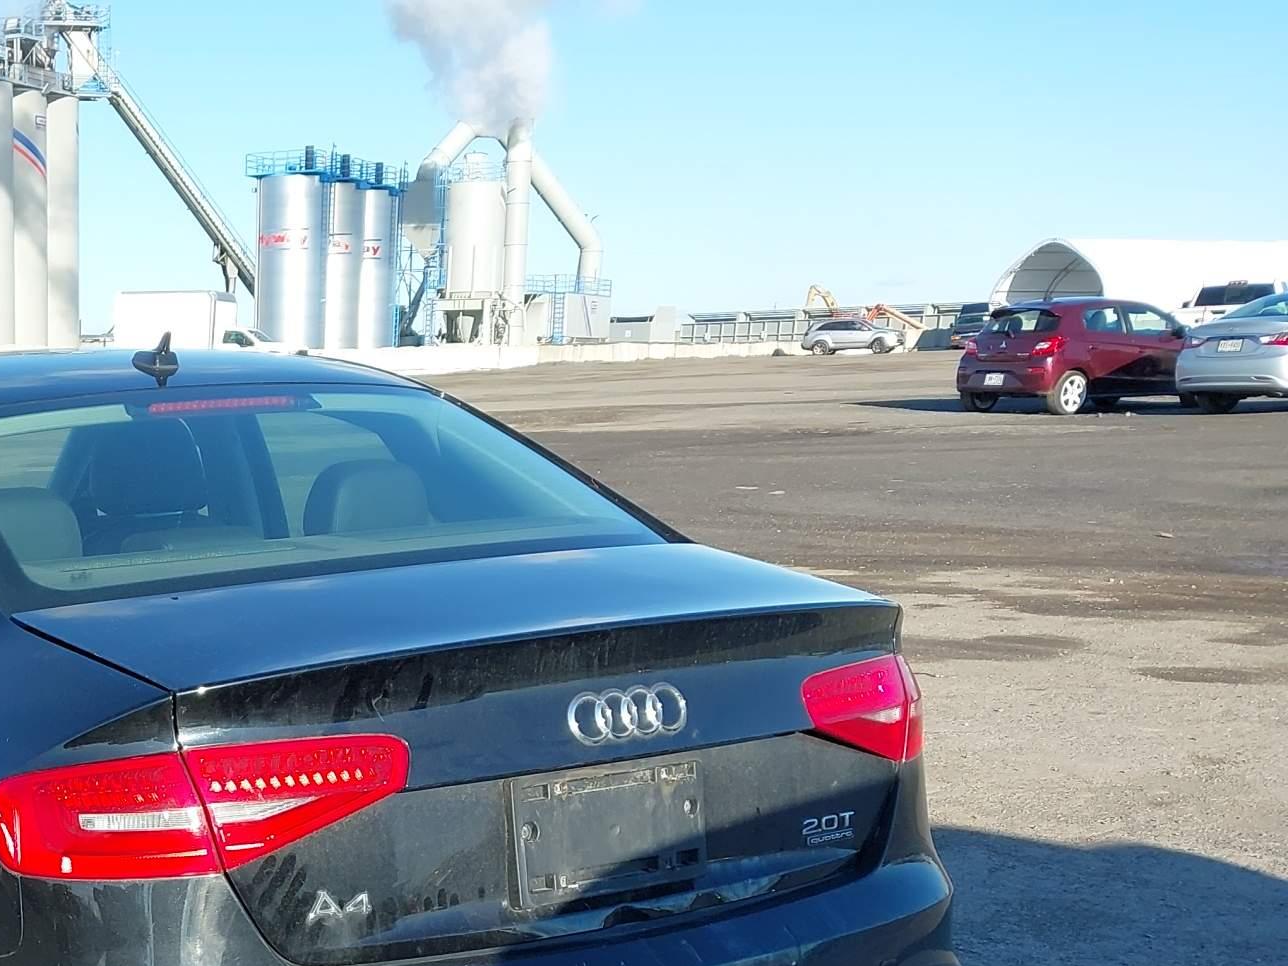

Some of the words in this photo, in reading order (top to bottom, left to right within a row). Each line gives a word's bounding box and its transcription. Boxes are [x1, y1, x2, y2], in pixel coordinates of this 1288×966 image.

[802, 811, 855, 835] 2.0T
[810, 830, 853, 844] quattro
[307, 890, 372, 921] A4
